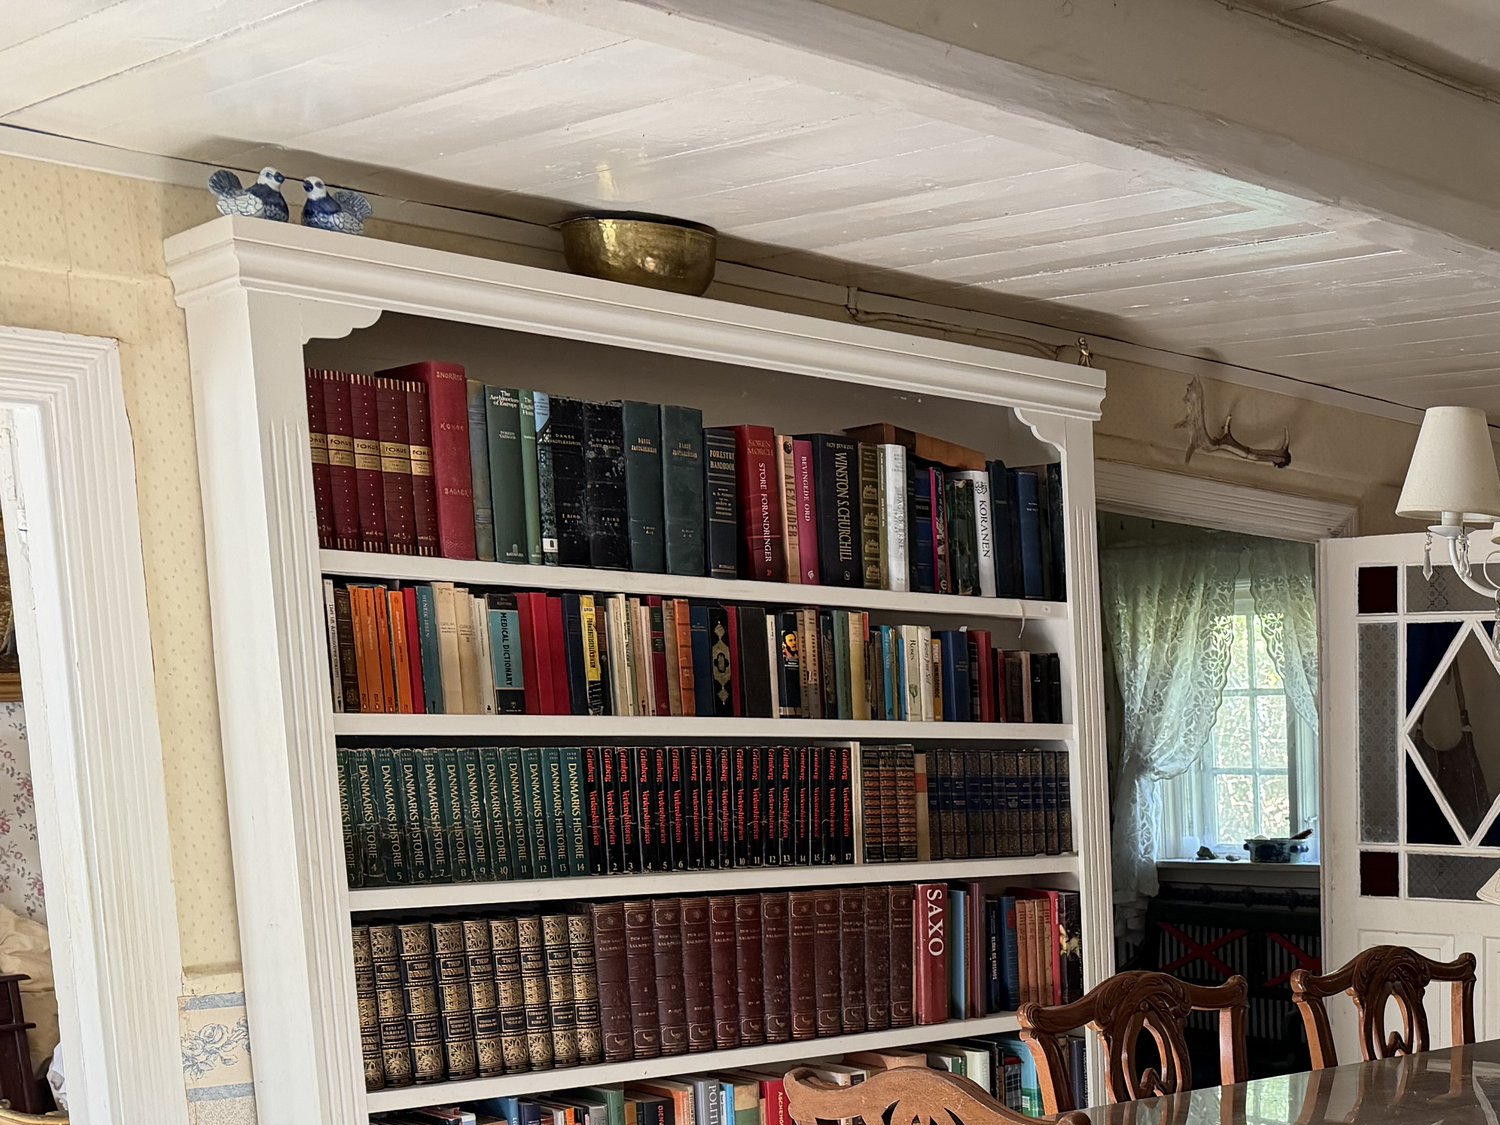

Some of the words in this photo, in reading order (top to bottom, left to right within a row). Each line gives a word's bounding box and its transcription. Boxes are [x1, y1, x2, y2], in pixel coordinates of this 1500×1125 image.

[499, 401, 517, 409] Europe
[357, 443, 379, 451] FOKUS
[385, 446, 407, 454] FOKUS
[758, 463, 767, 489] STORE
[834, 452, 849, 498] WINSTON
[979, 500, 990, 558] KORANEN
[500, 613, 508, 642] MEDICAL
[503, 645, 513, 686] DICTIONARY
[358, 765, 374, 822] DANMARKS
[381, 765, 397, 825] DANMARKS
[403, 764, 419, 824] DANMARKS
[425, 764, 440, 823] DANMARKS
[447, 764, 462, 824] DANMARKS
[466, 763, 481, 824] DANMARKS
[486, 763, 501, 823] DANMARKS
[508, 763, 522, 822] DANMARKS
[529, 763, 543, 818] DANMARKS
[549, 763, 563, 819] DANMARKS
[567, 763, 581, 817] DANMARKS
[387, 826, 403, 868] HISTORIE
[409, 825, 424, 866] HISTORIE
[431, 824, 446, 865] HISTORIE
[453, 823, 468, 864] HISTORIE
[473, 824, 487, 863] HISTORIE
[493, 822, 507, 863] HISTORIE
[514, 823, 527, 861] HISTORIE
[534, 819, 547, 861] HISTORIE
[555, 819, 566, 860] HISTORIE
[573, 817, 584, 860] HISTORIE
[927, 889, 944, 957] SAXO
